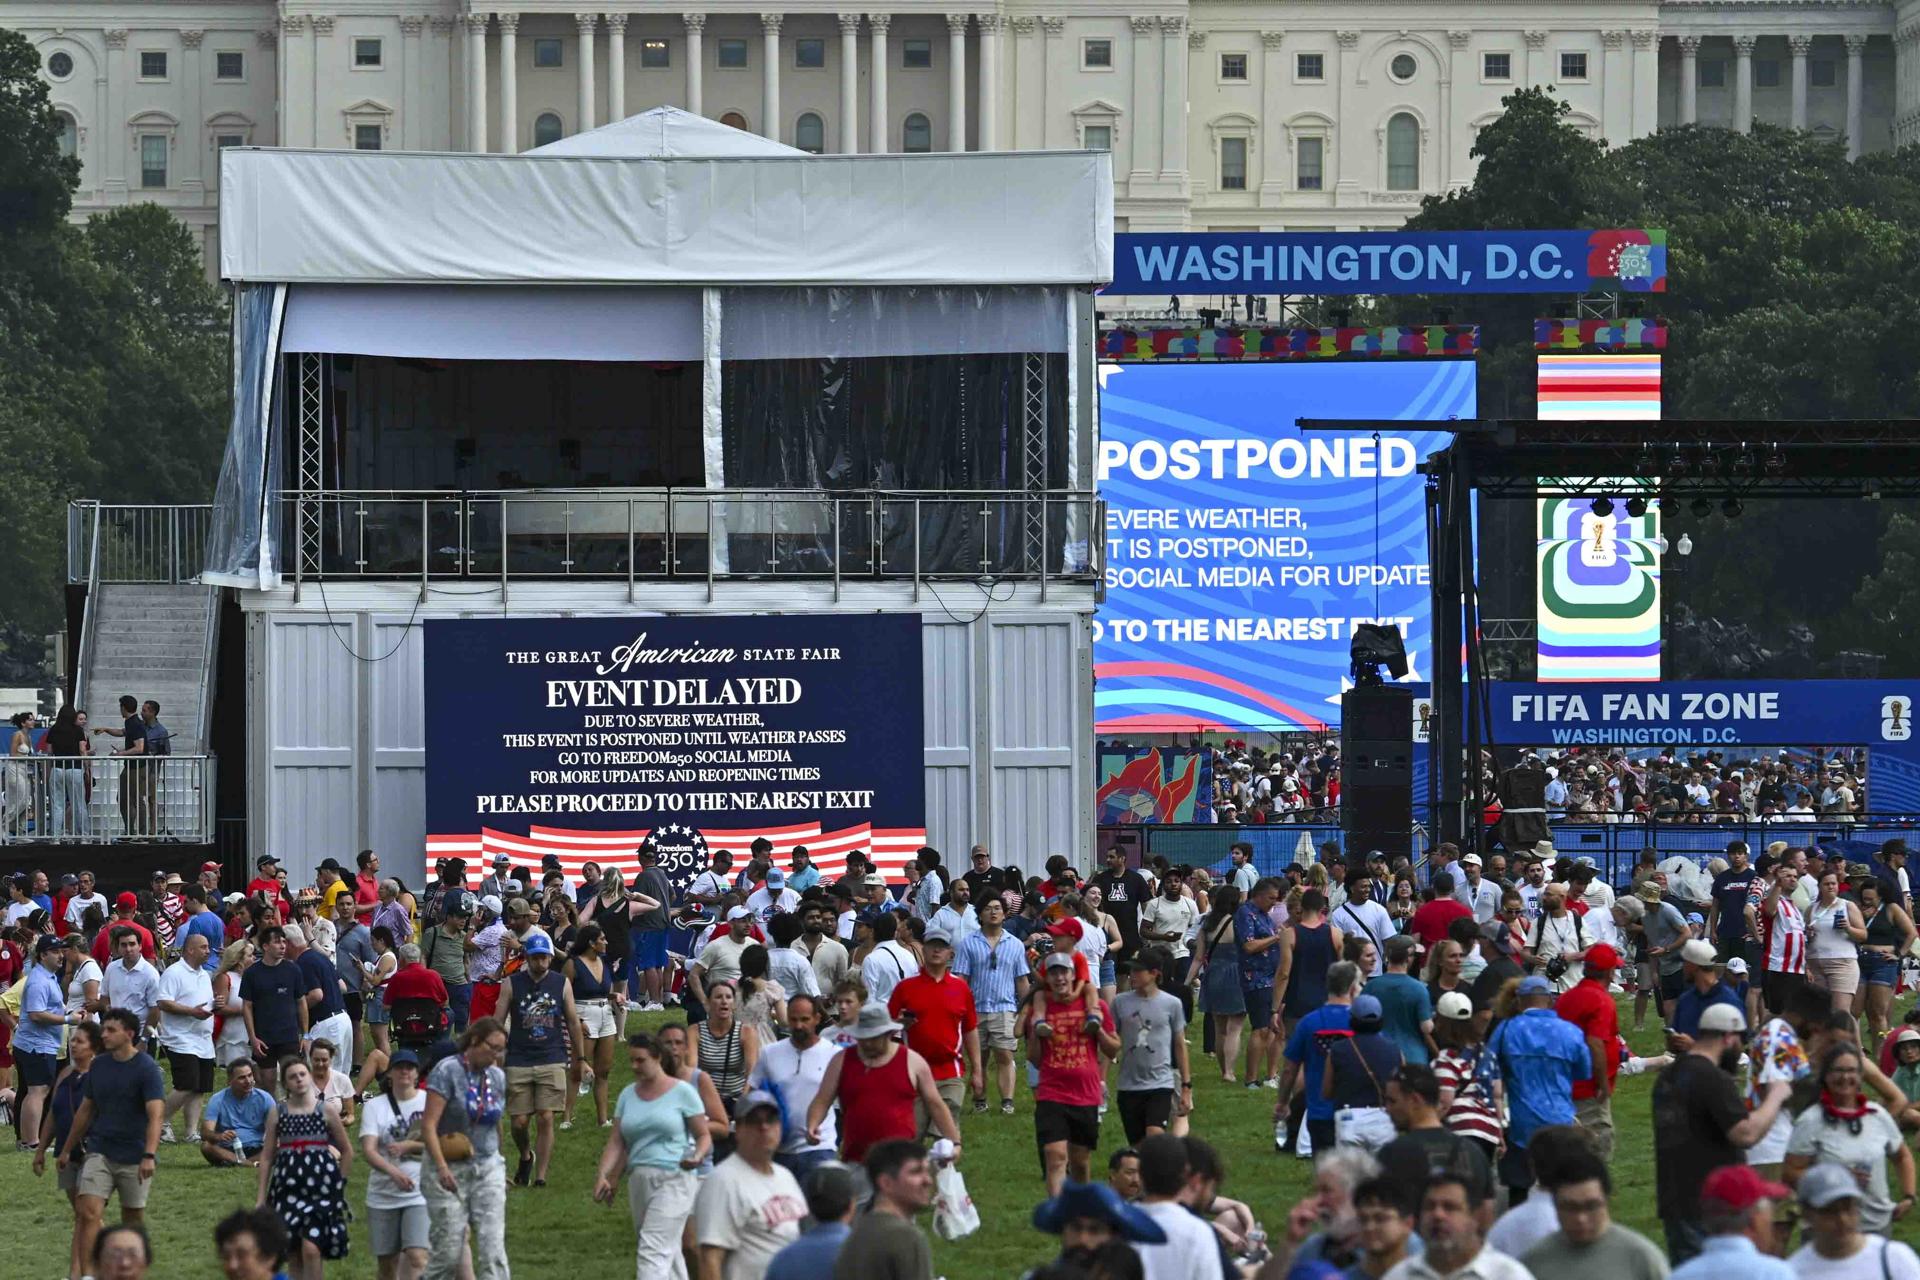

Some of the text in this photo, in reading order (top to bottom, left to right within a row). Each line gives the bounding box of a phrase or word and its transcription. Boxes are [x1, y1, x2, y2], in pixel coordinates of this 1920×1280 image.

[1134, 244, 1573, 285] WASHINGTON, D.C.
[1097, 438, 1416, 480] POSTPONED
[1107, 508, 1307, 530] EVERE WEATHER,
[1130, 538, 1151, 558] IS
[1159, 537, 1313, 560] POSTPONED,
[1106, 564, 1430, 588] SOCIAL MEDIA FOR UPDATE
[1108, 619, 1147, 642] TO
[1153, 619, 1209, 641] THE
[1216, 618, 1345, 641] NEAREST
[506, 632, 840, 675] THE GREAT American STATE FAIR
[546, 678, 801, 707] EVENT DELAYED
[1513, 693, 1779, 721] FIFA FAN ZONE
[585, 713, 764, 727] DUE TO SEVERE WEATHER,
[503, 730, 846, 747] THIS EVENT IS POSTPONED UNTIL WEATHER PASSES
[1703, 728, 1741, 743] D.C.
[559, 750, 792, 766] GO TO FREEDOM250 SOCIAL MEDIA
[530, 768, 820, 783] FOR MORE UPDATES AND REOPENING TIMES
[477, 791, 874, 813] PLEASE PROCEED TO THE NEAREST EXIT
[656, 844, 694, 852] Freedom
[657, 852, 694, 873] 250
[1108, 882, 1128, 902] A
